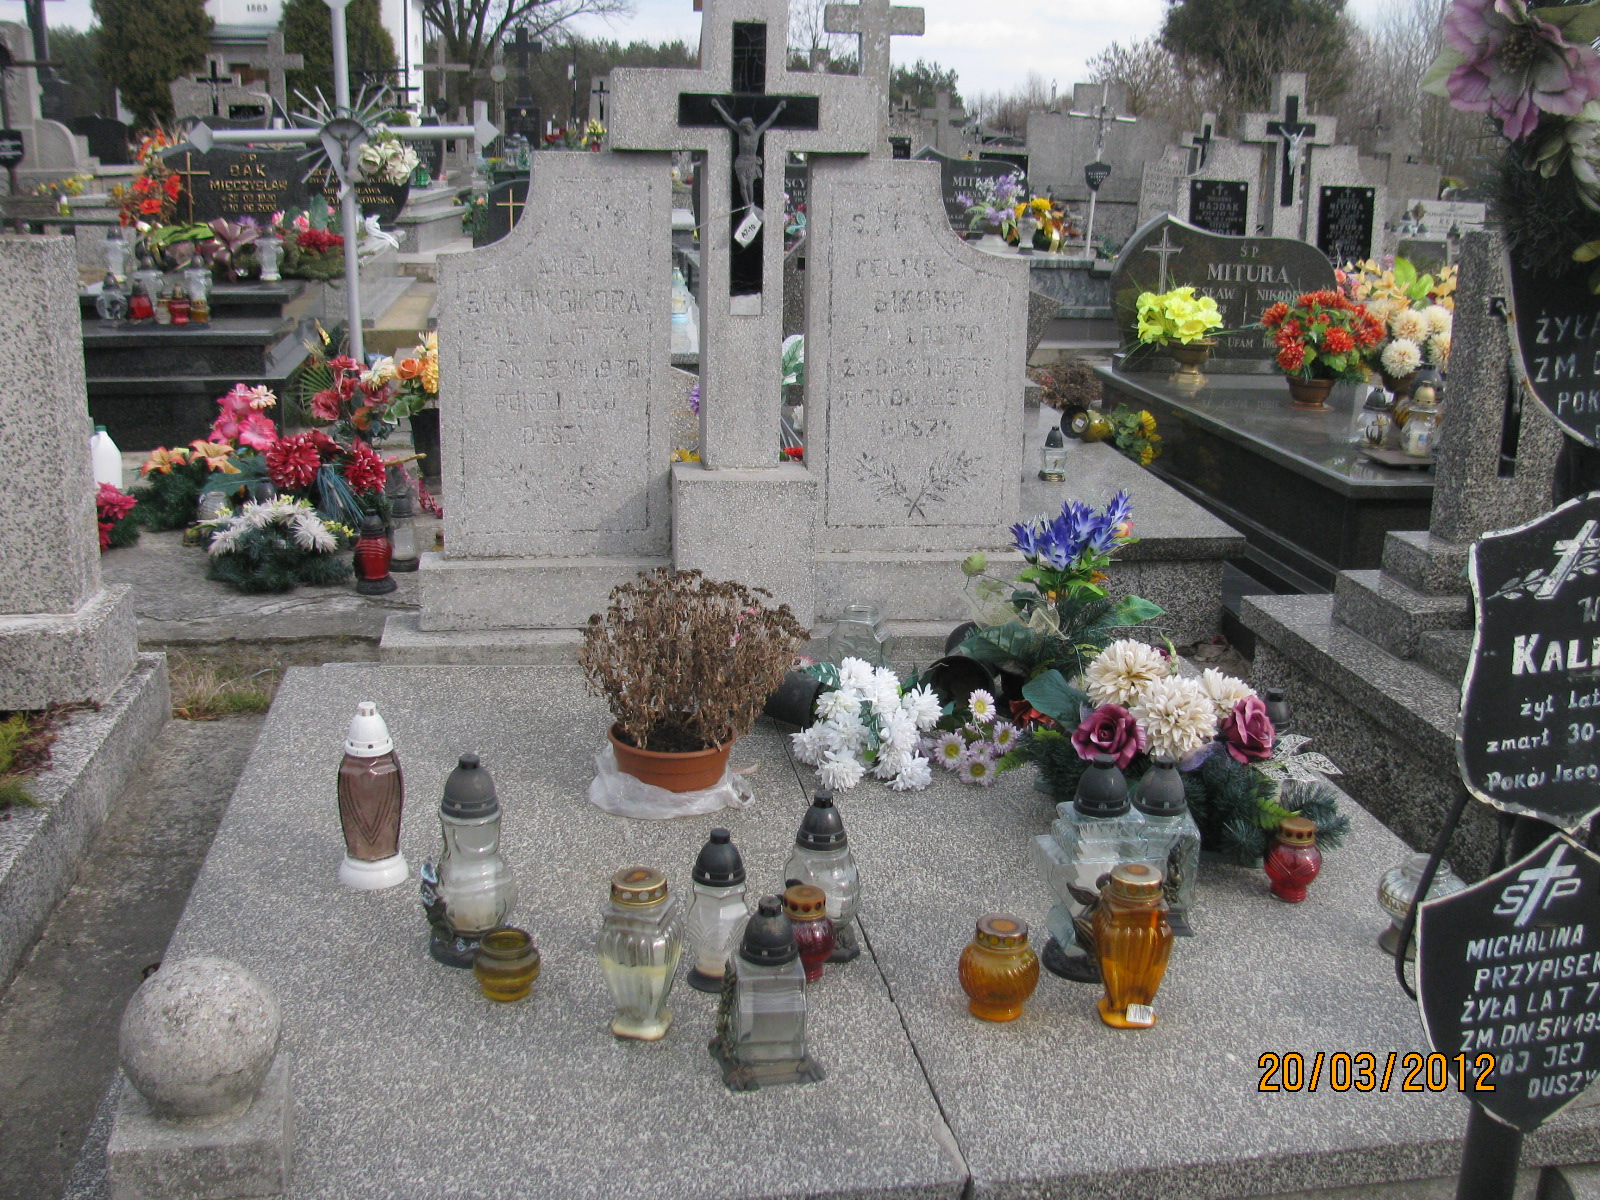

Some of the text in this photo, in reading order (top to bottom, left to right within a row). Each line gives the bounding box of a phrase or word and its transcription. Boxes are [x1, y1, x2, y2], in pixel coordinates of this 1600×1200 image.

[1207, 263, 1290, 283] MITURA
[1466, 924, 1585, 963] MICHALINA
[1460, 981, 1600, 1023] ŻYŁA LAT 7
[1543, 1042, 1585, 1068] JEJ
